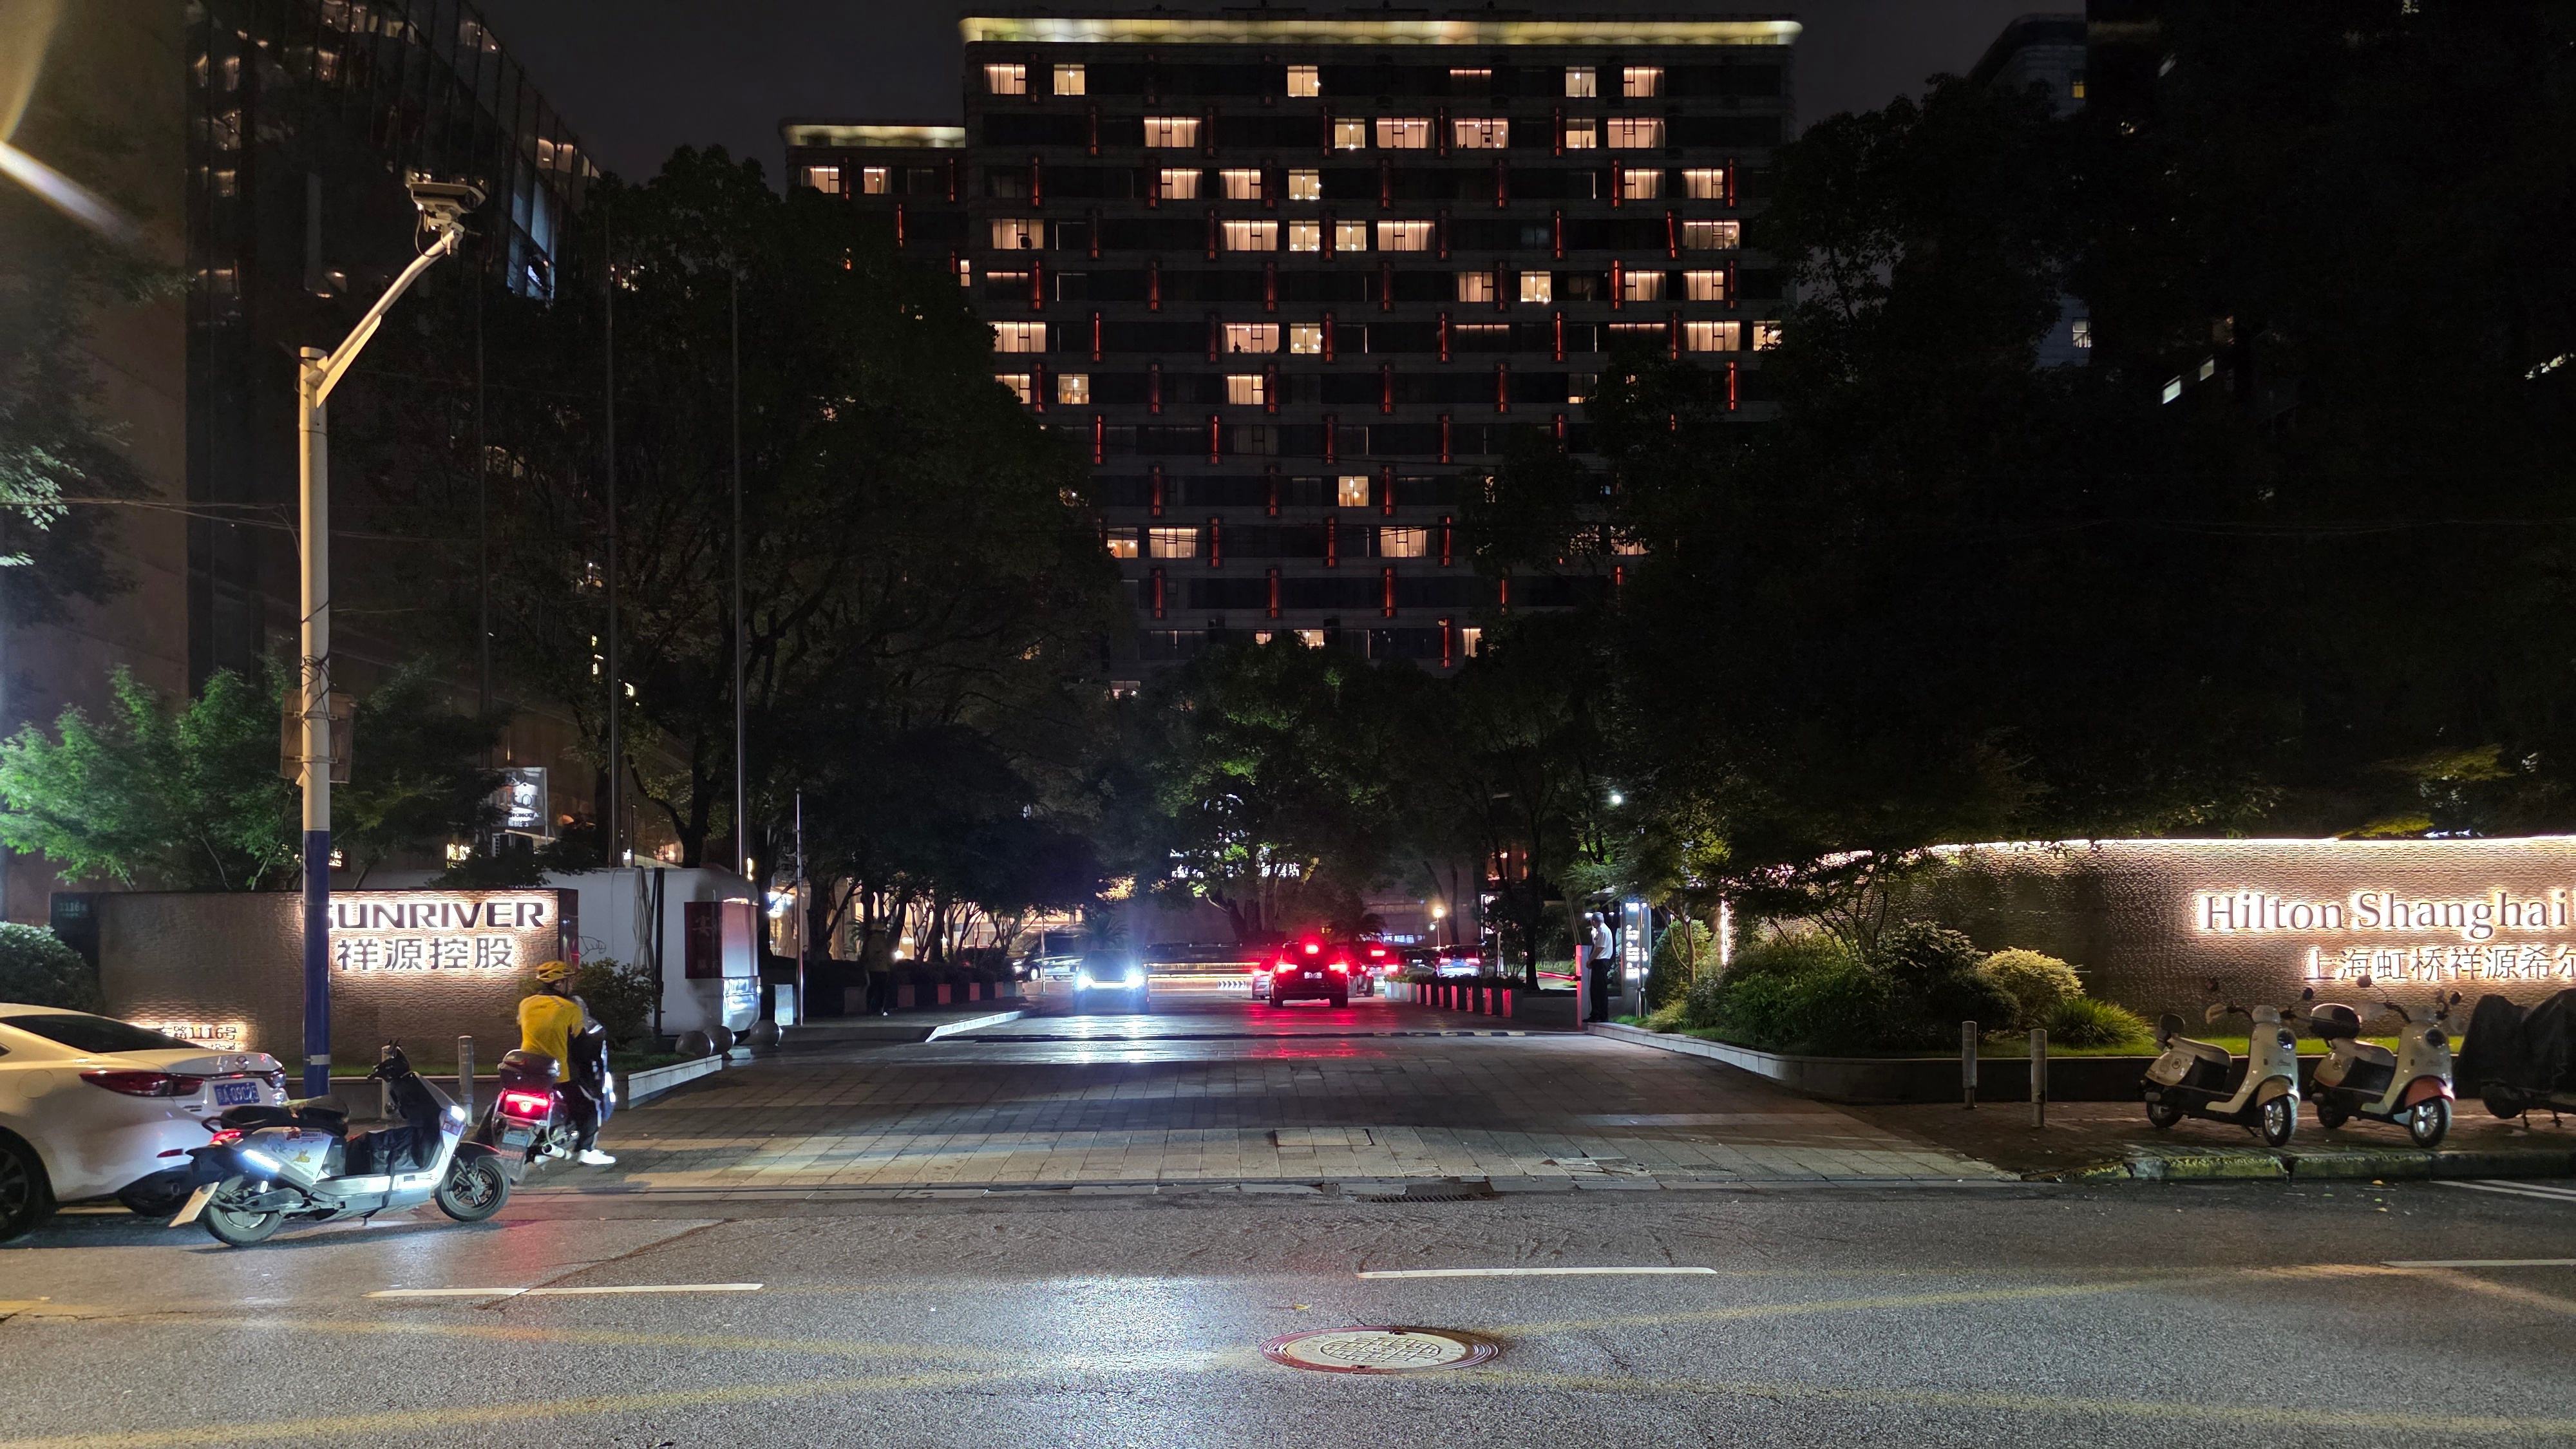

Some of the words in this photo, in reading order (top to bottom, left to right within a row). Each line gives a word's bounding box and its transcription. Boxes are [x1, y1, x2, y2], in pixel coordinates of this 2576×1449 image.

[328, 902, 545, 929] UNRIVER
[2204, 893, 2344, 930] Hilton
[2358, 891, 2568, 940] Shanghai
[337, 937, 513, 971] 祥源控股
